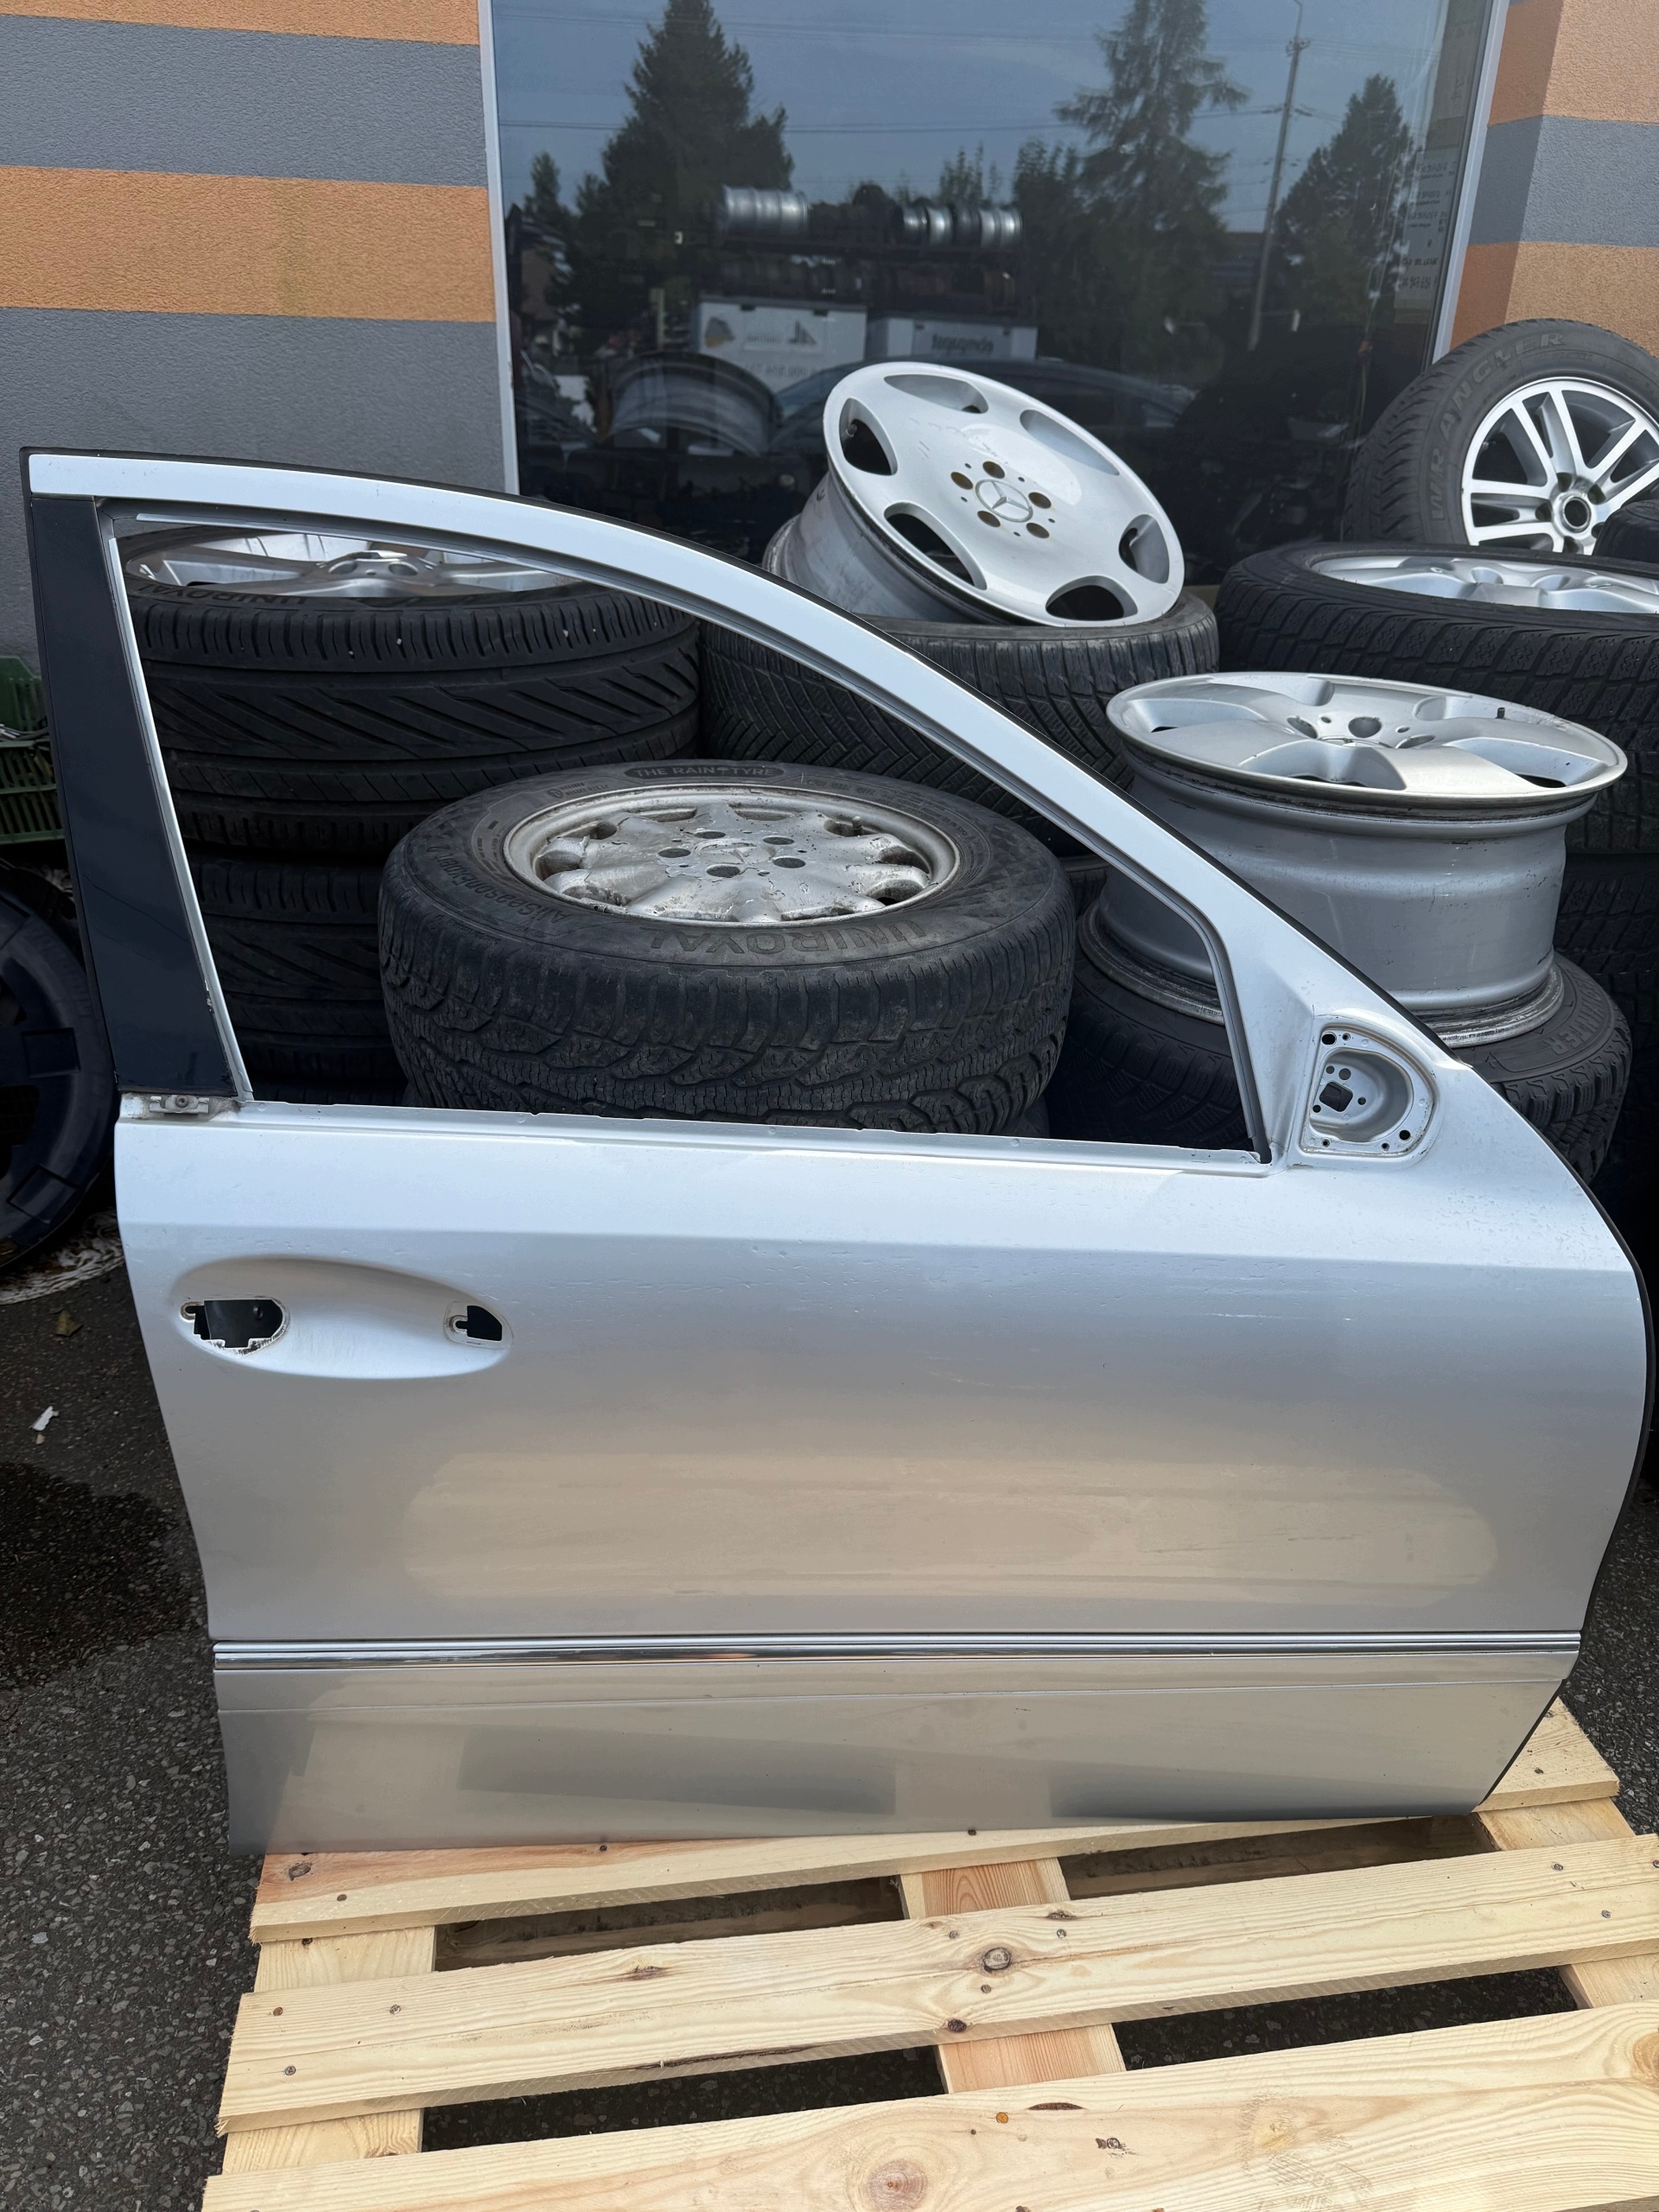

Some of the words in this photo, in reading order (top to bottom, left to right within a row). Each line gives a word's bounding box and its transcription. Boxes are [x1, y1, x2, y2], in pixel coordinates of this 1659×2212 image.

[1430, 333, 1565, 520] WRANGLER
[138, 583, 308, 605] UNIROYAL
[634, 768, 668, 777] THE
[674, 766, 715, 775] RAIN
[731, 766, 774, 777] TYRE
[640, 920, 927, 954] UNIROYAL
